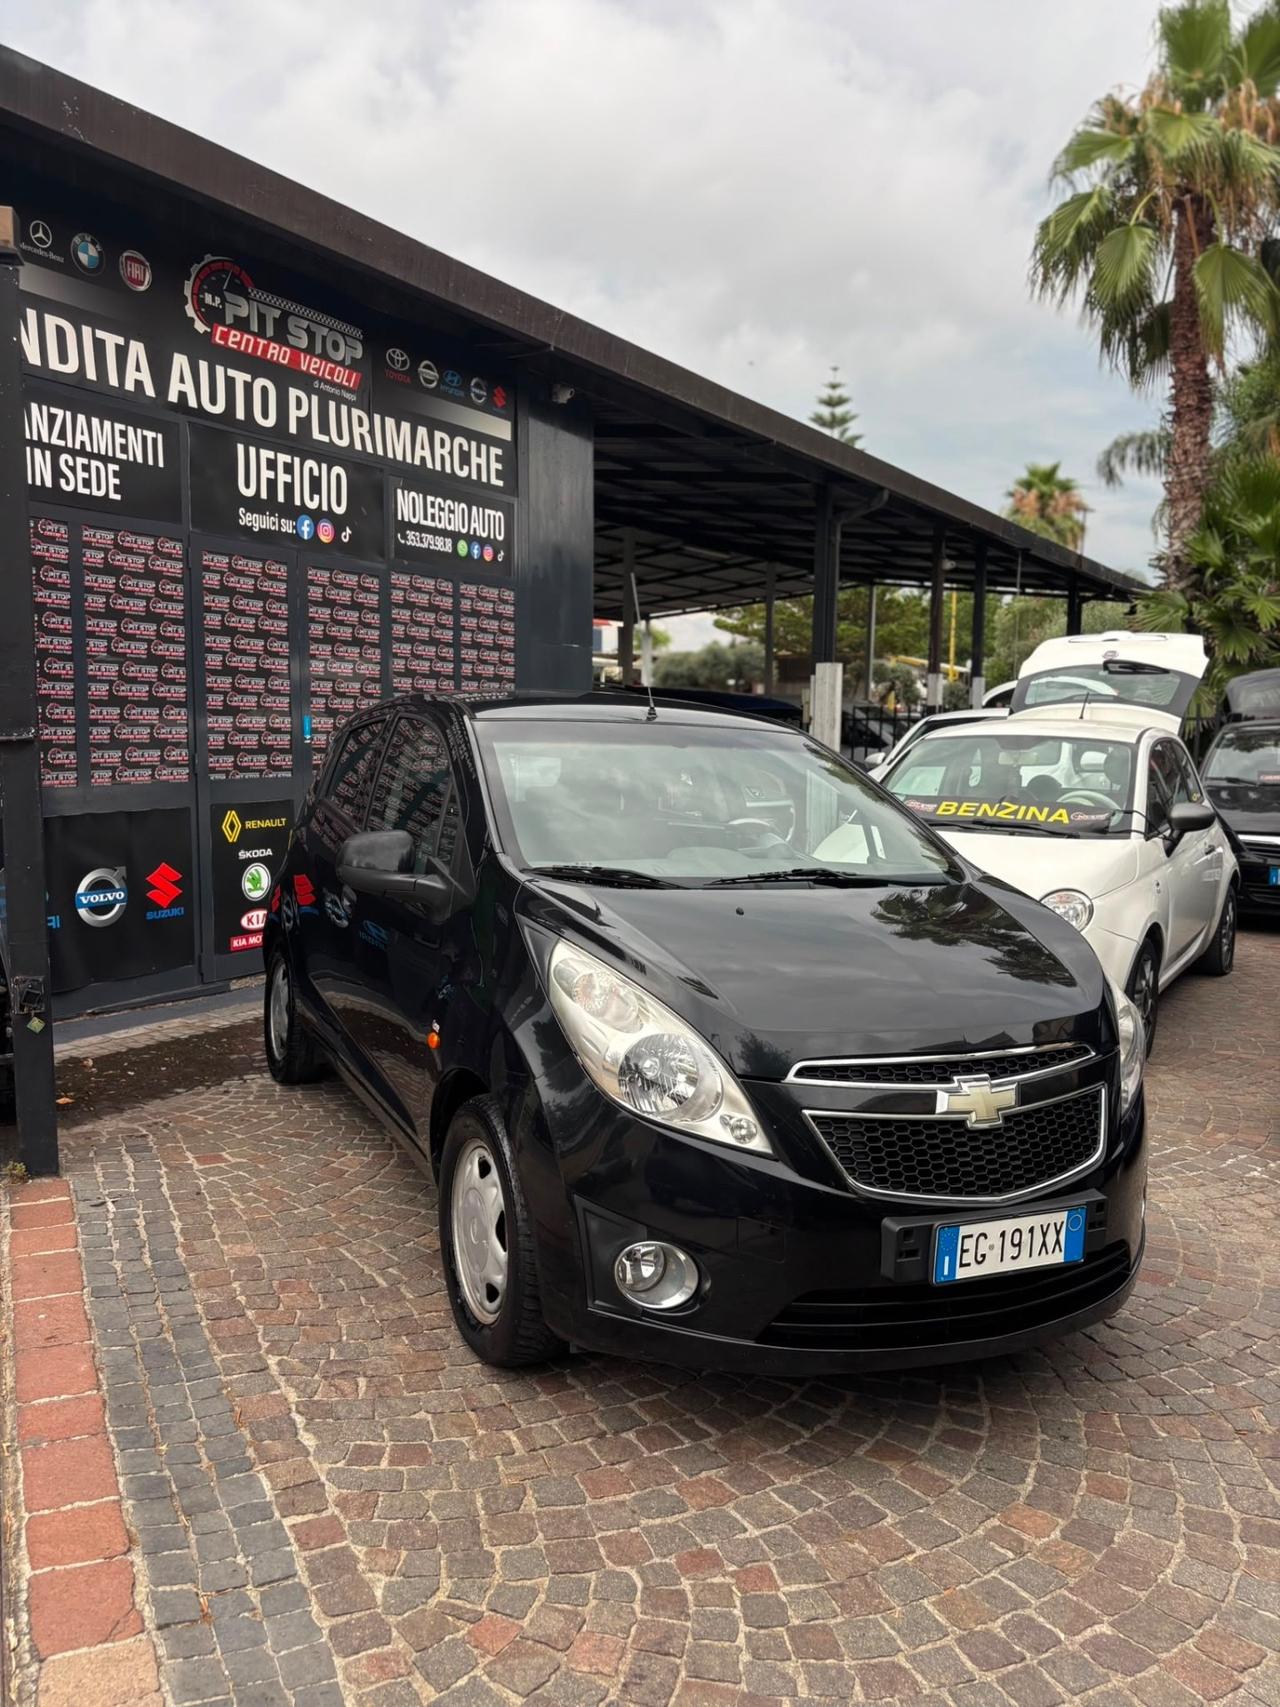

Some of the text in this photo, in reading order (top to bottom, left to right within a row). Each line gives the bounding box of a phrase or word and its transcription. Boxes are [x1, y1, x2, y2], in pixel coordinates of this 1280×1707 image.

[127, 260, 145, 281] FIAT
[223, 291, 363, 366] PIT STOP
[319, 383, 341, 396] Antonio
[167, 352, 278, 428] AUTO
[288, 386, 504, 487] PLURIMARCHE
[26, 446, 121, 500] IN SEDE
[237, 443, 348, 515] UFFICIO
[238, 507, 296, 535] Seguici su:
[397, 488, 504, 541] NOLEGGIO AUTO
[245, 818, 287, 829] RENAULT
[936, 801, 1070, 824] BENZINA
[238, 848, 273, 860] ŠKODA
[80, 890, 126, 904] VOLVO
[145, 906, 185, 921] SUZUKI
[232, 938, 247, 948] KIA
